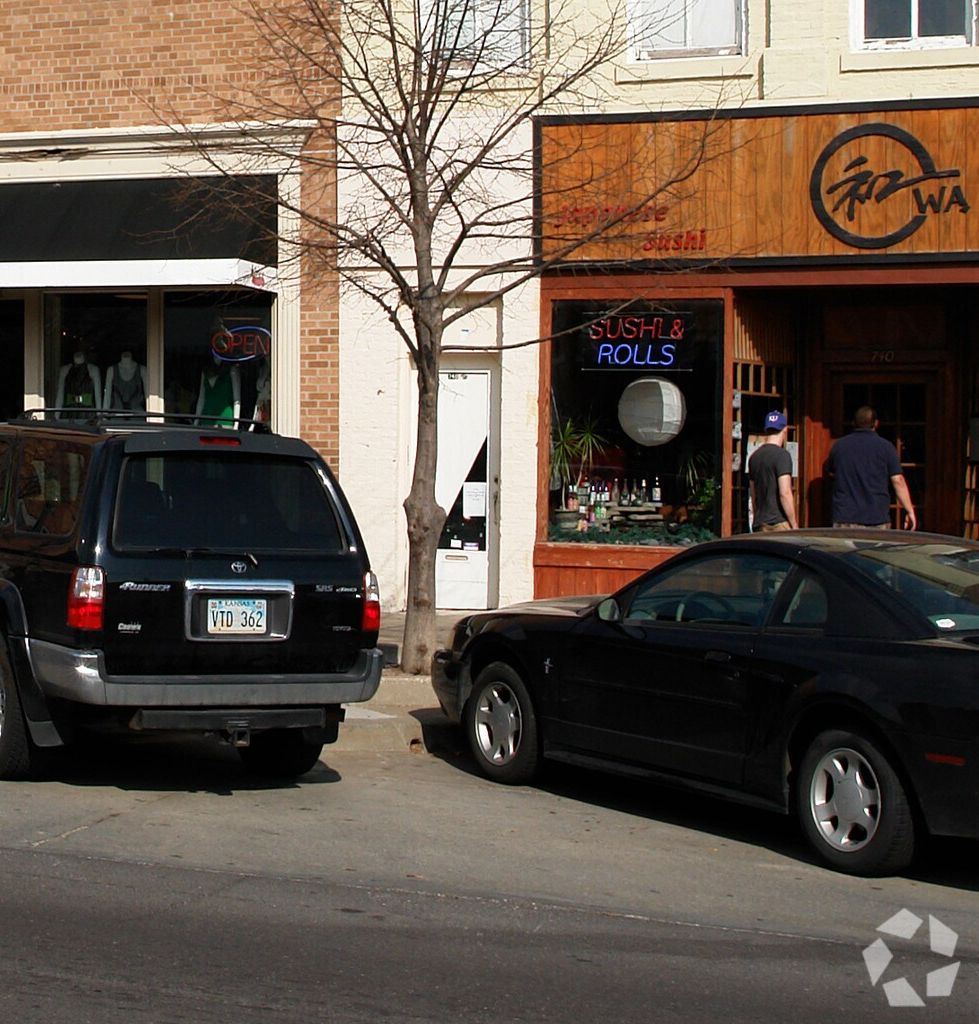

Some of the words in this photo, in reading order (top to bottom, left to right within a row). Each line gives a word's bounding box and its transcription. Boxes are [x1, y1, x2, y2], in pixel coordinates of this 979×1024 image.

[913, 185, 971, 214] WA
[211, 331, 271, 356] OPEN
[597, 343, 676, 366] ROLLS
[211, 610, 234, 628] VTD
[240, 610, 263, 628] 362
